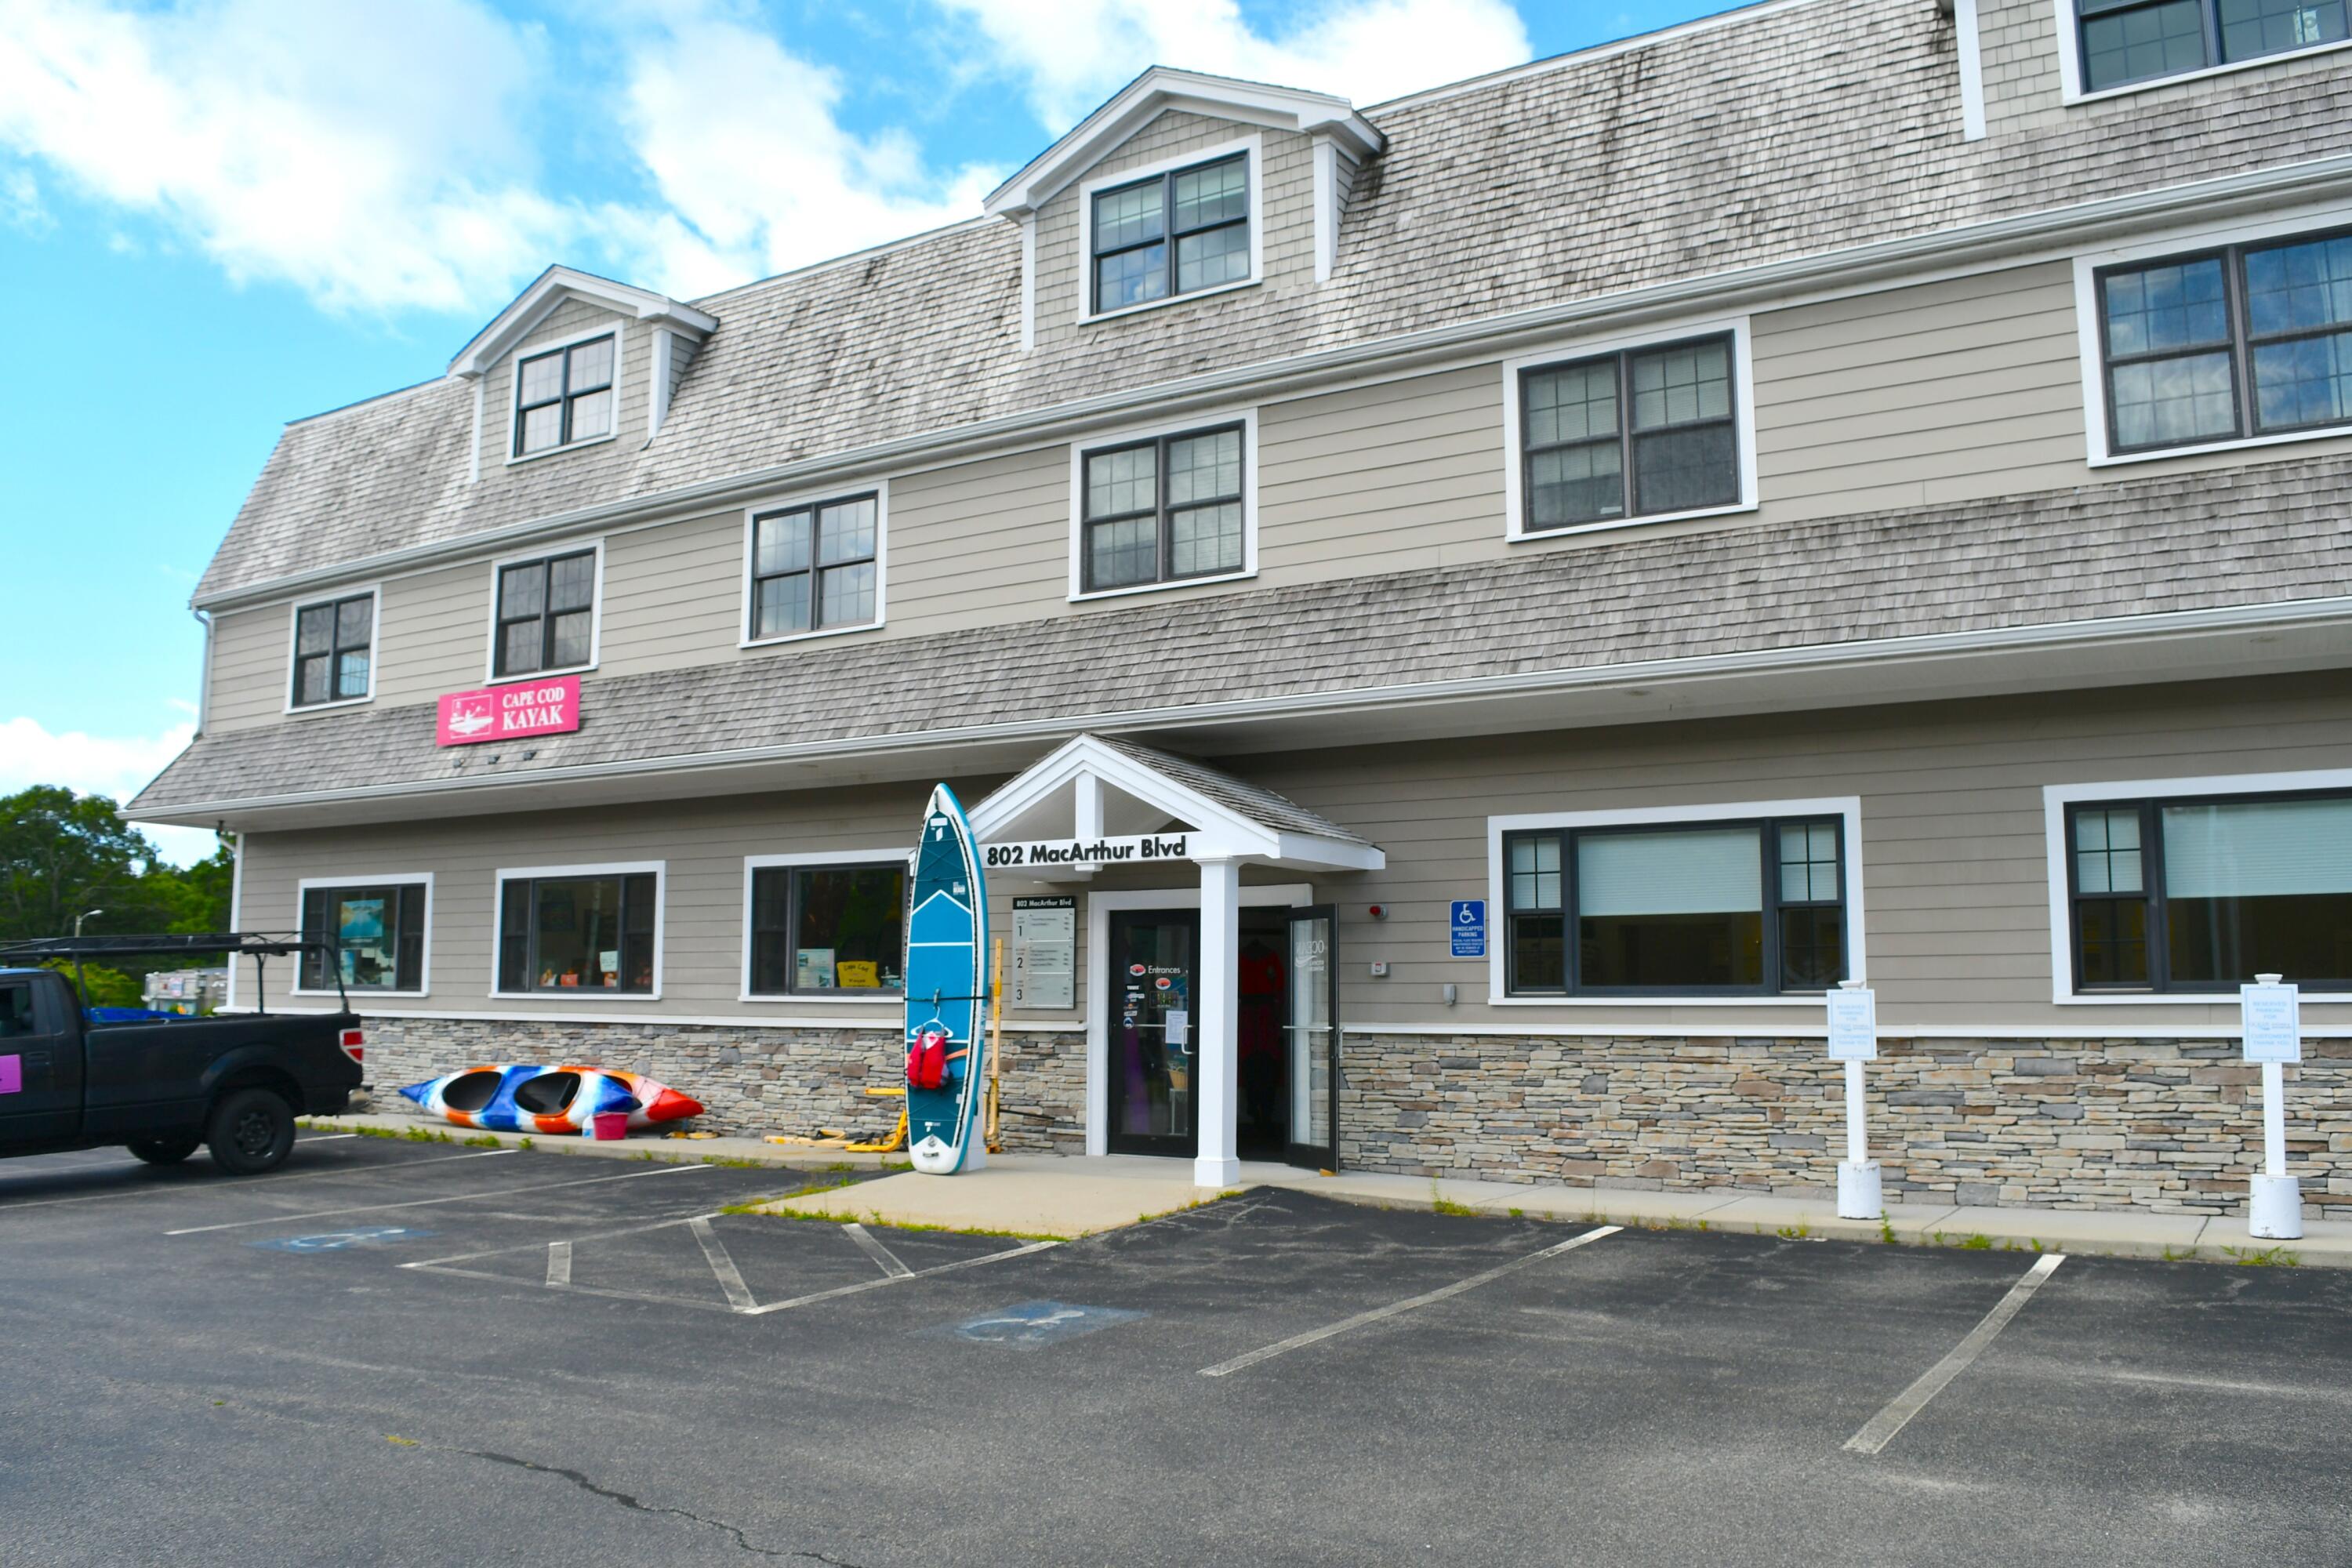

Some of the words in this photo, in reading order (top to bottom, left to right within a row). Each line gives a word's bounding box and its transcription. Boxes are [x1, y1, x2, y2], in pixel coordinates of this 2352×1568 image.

[502, 690, 535, 709] CAPE
[537, 687, 565, 704] COD
[502, 704, 564, 731] KAYAK
[987, 846, 1023, 866] 802
[1029, 840, 1134, 864] MacArthur
[1141, 835, 1186, 858] Blvd
[1029, 898, 1058, 907] MacArthur
[1059, 898, 1072, 906] Blvd
[1018, 925, 1022, 937] 1
[1016, 956, 1023, 969] 2
[1148, 965, 1181, 974] Entrances
[1016, 989, 1022, 1000] 3
